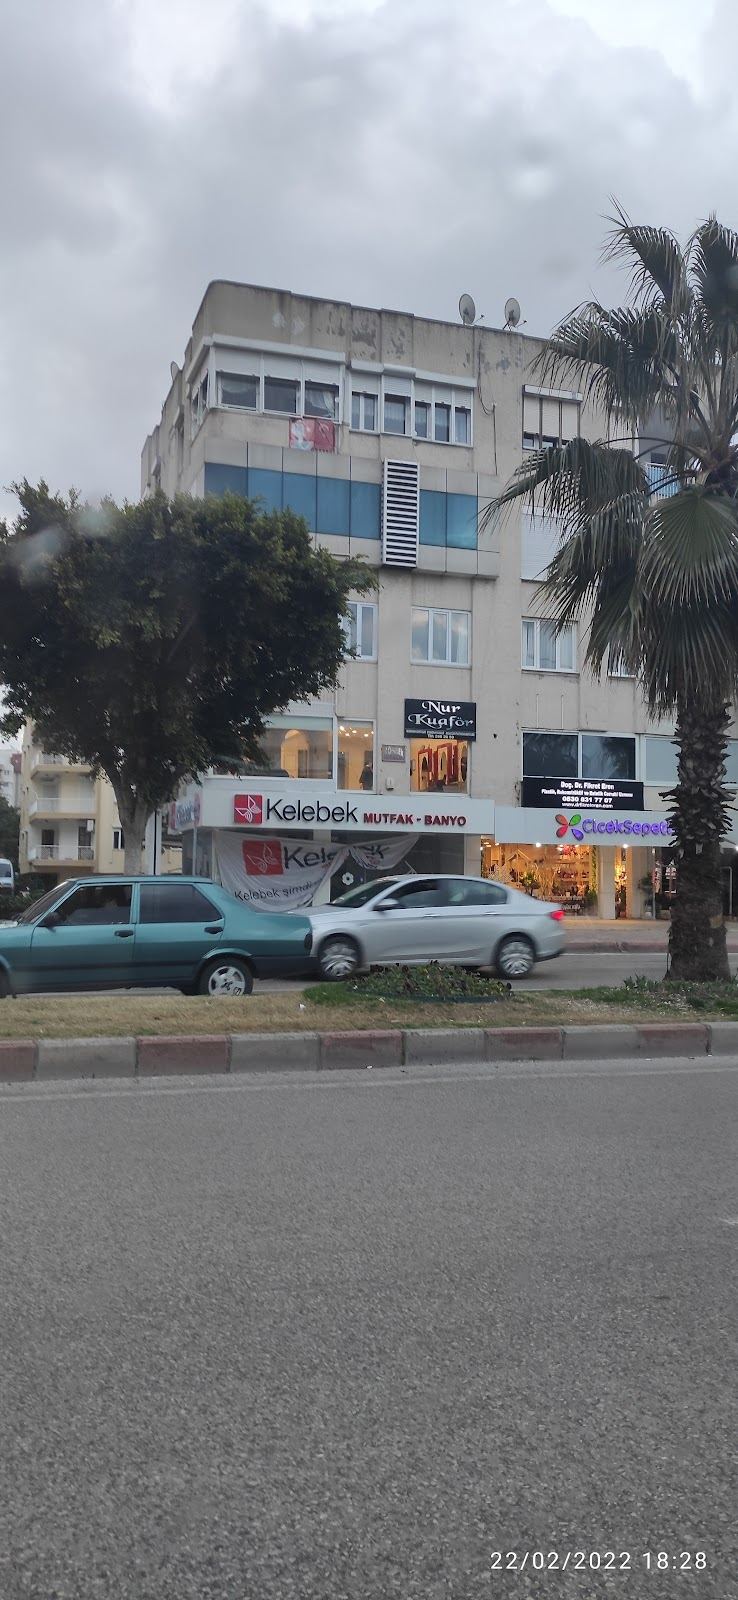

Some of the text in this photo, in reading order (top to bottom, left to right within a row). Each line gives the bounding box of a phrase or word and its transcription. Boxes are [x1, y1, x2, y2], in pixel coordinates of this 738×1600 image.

[422, 701, 461, 715] Nur
[408, 714, 474, 730] Kuaför
[583, 782, 601, 790] Fikret
[266, 799, 358, 823] Kelebek
[363, 812, 413, 825] MUTFAK
[424, 814, 467, 826] BANYO
[234, 884, 281, 902] Kelebek
